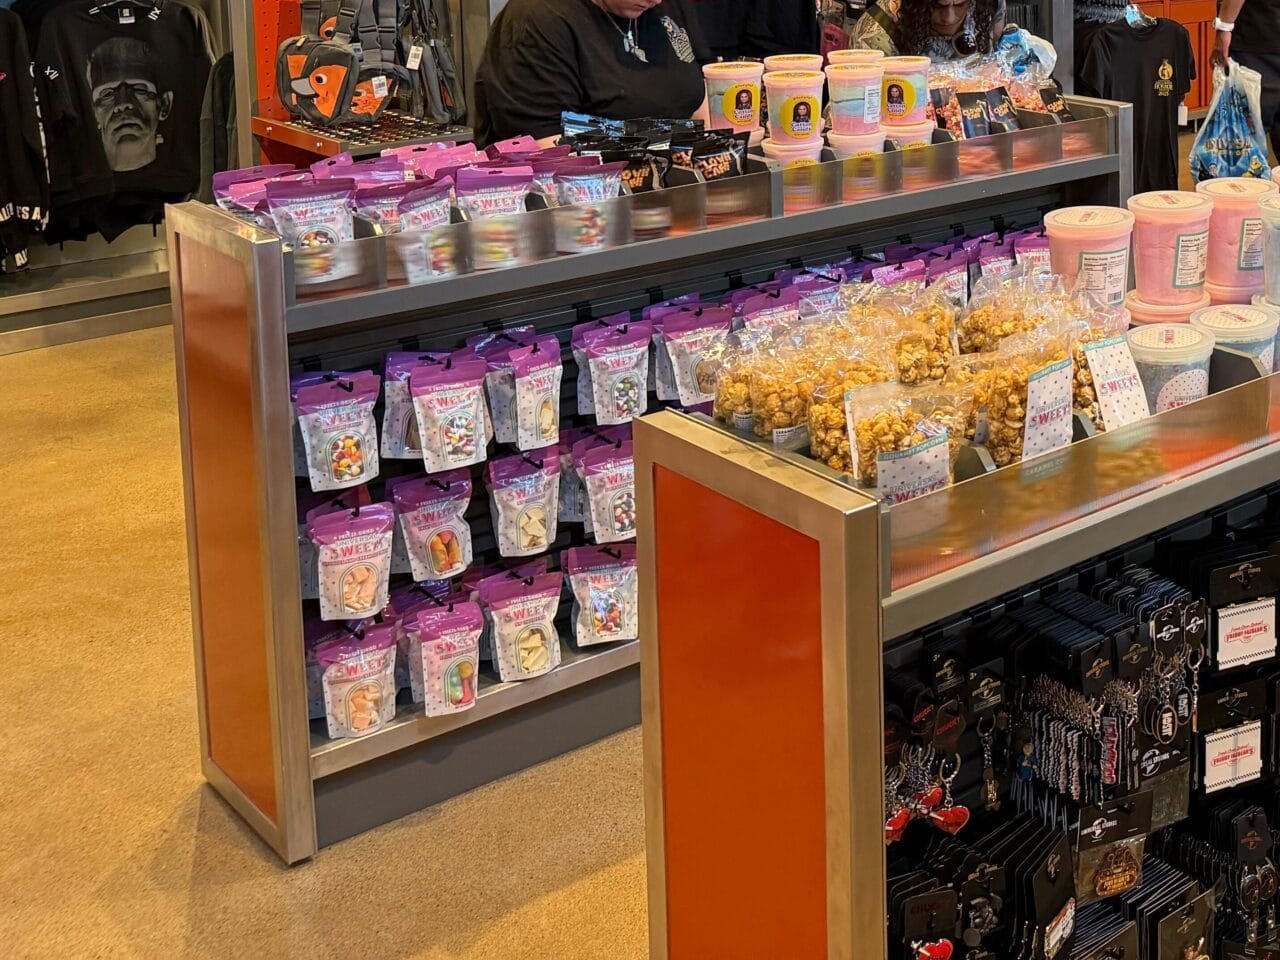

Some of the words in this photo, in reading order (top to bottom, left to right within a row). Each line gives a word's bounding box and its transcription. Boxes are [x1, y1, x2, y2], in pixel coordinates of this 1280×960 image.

[1100, 374, 1140, 395] SWEETS
[1029, 403, 1072, 428] SWEETS
[916, 435, 946, 452] POPCORN
[330, 540, 385, 560] SWEETS
